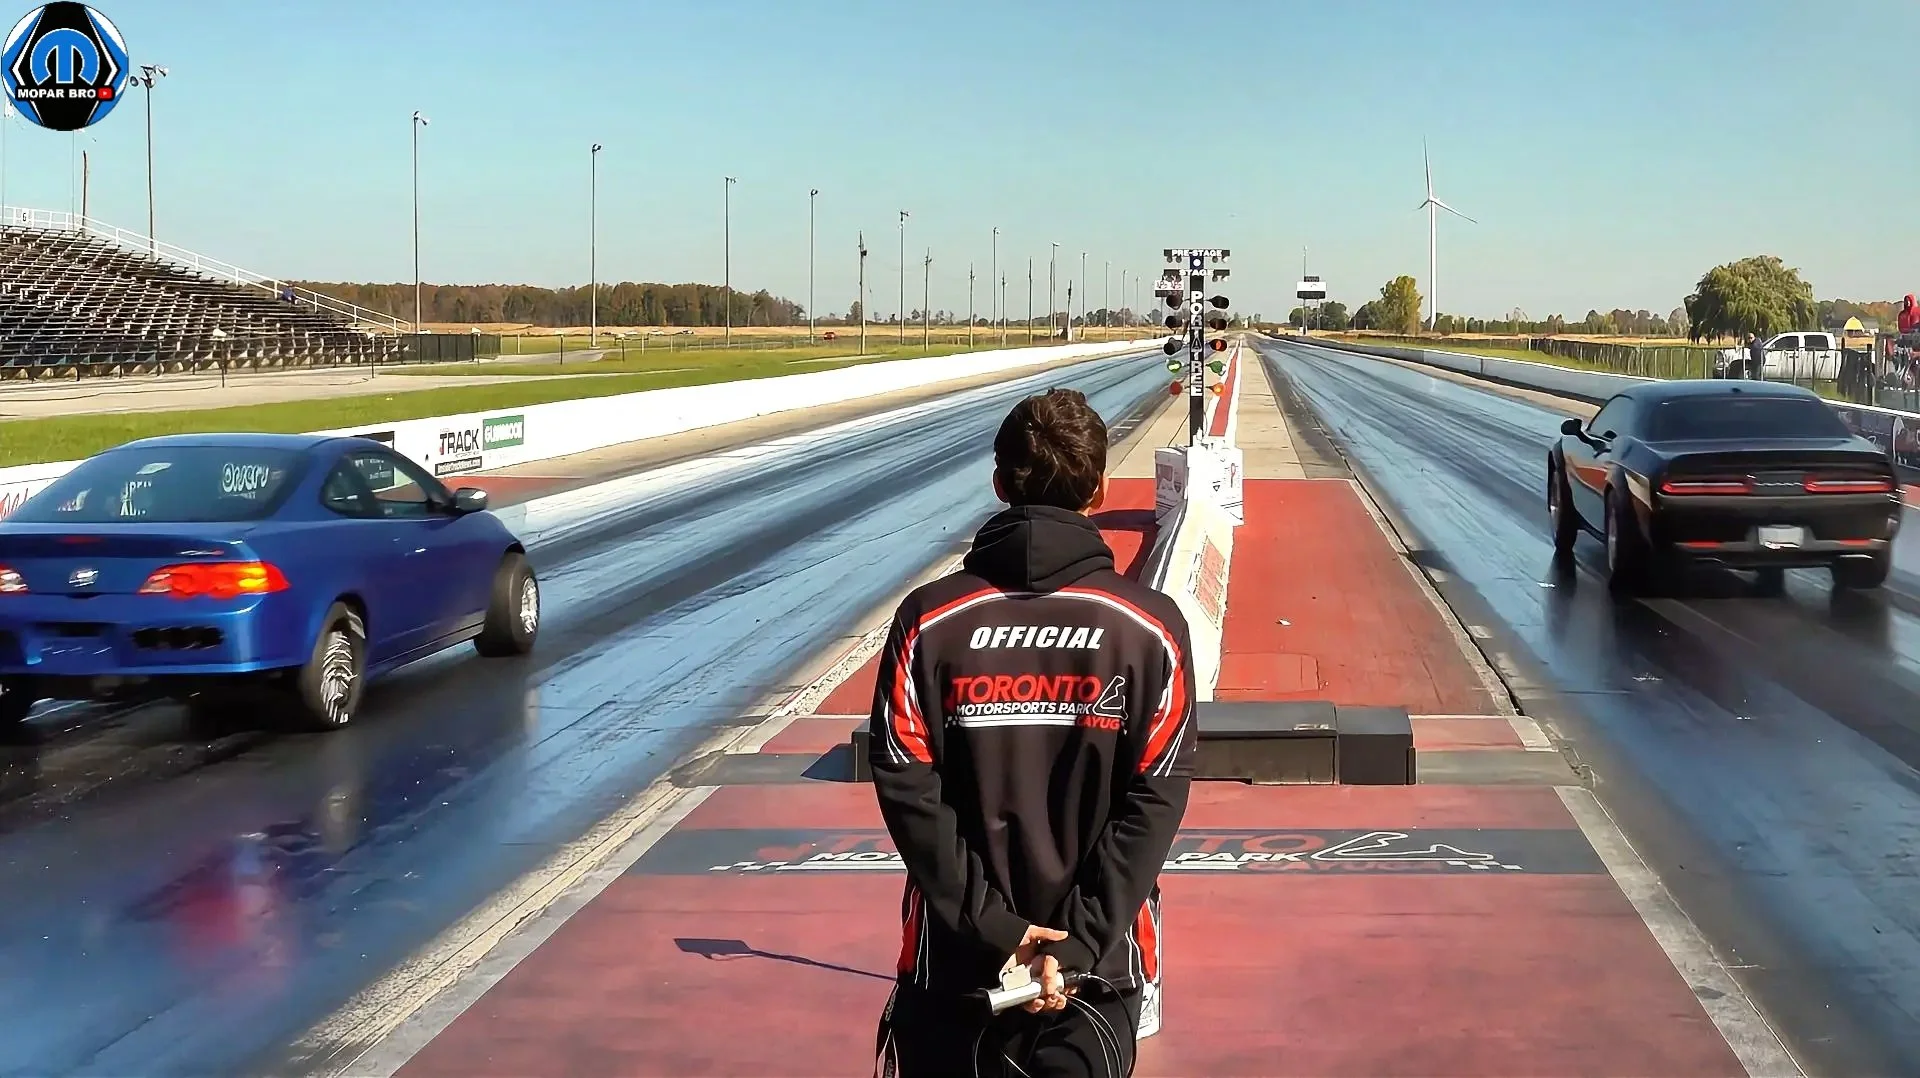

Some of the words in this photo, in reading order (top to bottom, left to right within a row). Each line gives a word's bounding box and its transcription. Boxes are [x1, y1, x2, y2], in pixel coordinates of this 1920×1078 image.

[1171, 249, 1223, 257] PRE-STAGE
[1179, 268, 1215, 276] STAGE
[1190, 290, 1204, 397] PORTATREE
[439, 428, 480, 455] TRACK
[969, 626, 1105, 650] OFFICIAL
[952, 674, 1103, 704] TORONTO
[956, 701, 1056, 715] MOTORSPORTS
[1058, 703, 1093, 715] PARK
[1077, 716, 1122, 731] CAYUG
[1176, 852, 1304, 865] PARK
